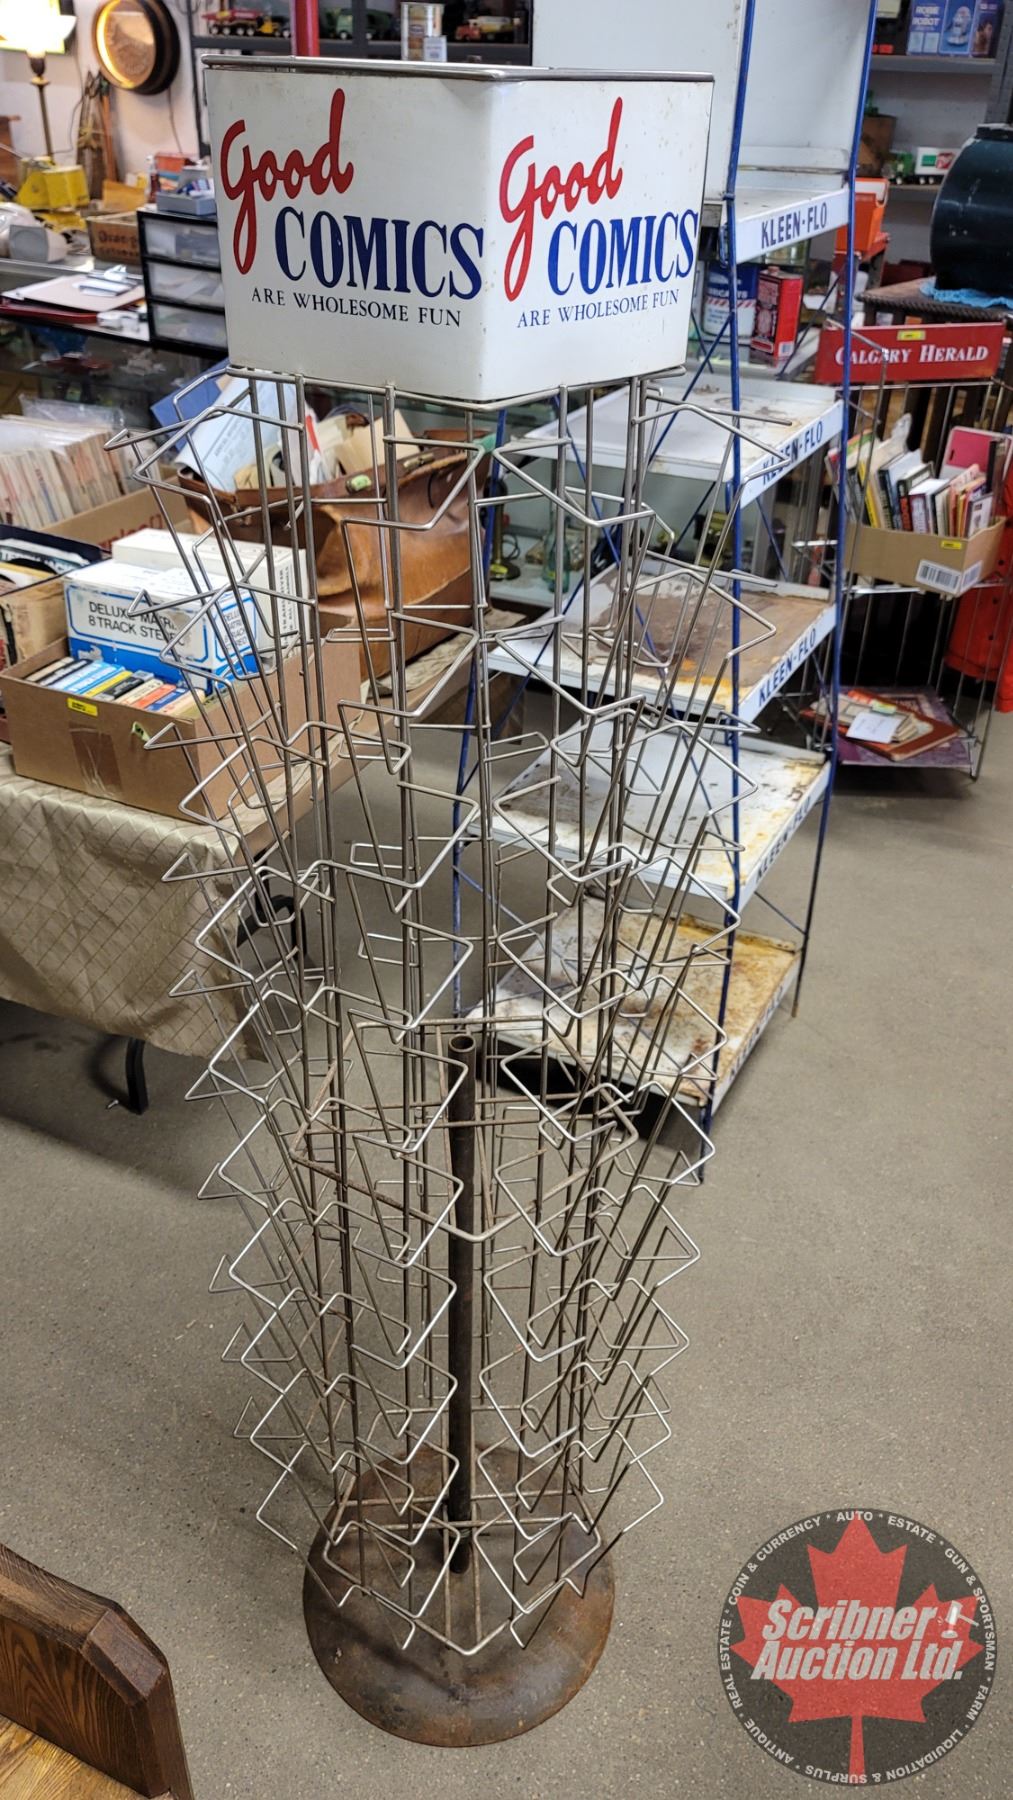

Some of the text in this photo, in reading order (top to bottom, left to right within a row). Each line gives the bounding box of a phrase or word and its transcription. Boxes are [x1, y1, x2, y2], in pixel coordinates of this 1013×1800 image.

[220, 88, 354, 275] Good
[499, 96, 623, 302] Good
[274, 206, 484, 300] COMICS
[548, 208, 699, 296] COMICS
[251, 287, 462, 328] ARE WHOLESOME FUN
[516, 288, 680, 329] ARE WHOLESOME FUN
[919, 344, 989, 363] HERALD
[88, 614, 186, 646] 8 TRACK STEE
